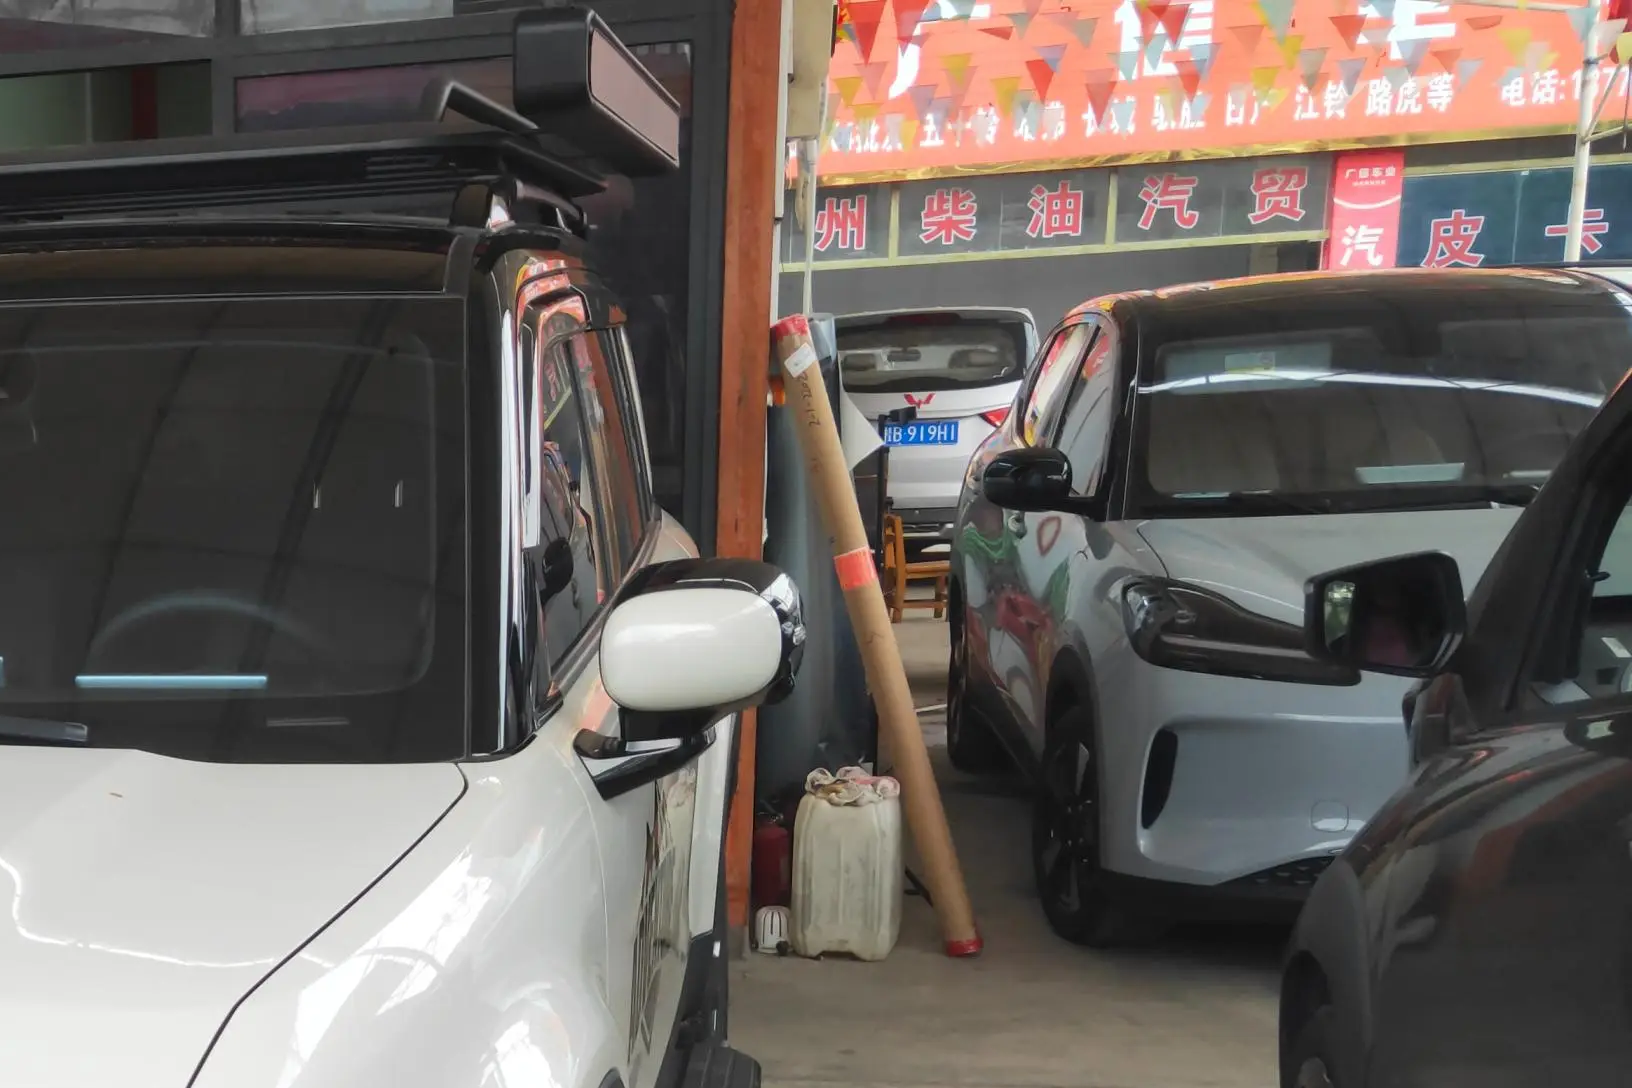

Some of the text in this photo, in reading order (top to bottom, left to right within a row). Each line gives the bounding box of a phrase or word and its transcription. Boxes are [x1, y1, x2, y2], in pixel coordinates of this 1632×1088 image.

[1365, 73, 1455, 117] 路虎等
[814, 166, 1309, 252] 州柴油汽贸
[1339, 224, 1384, 267] 汽
[1420, 208, 1610, 268] 皮卡
